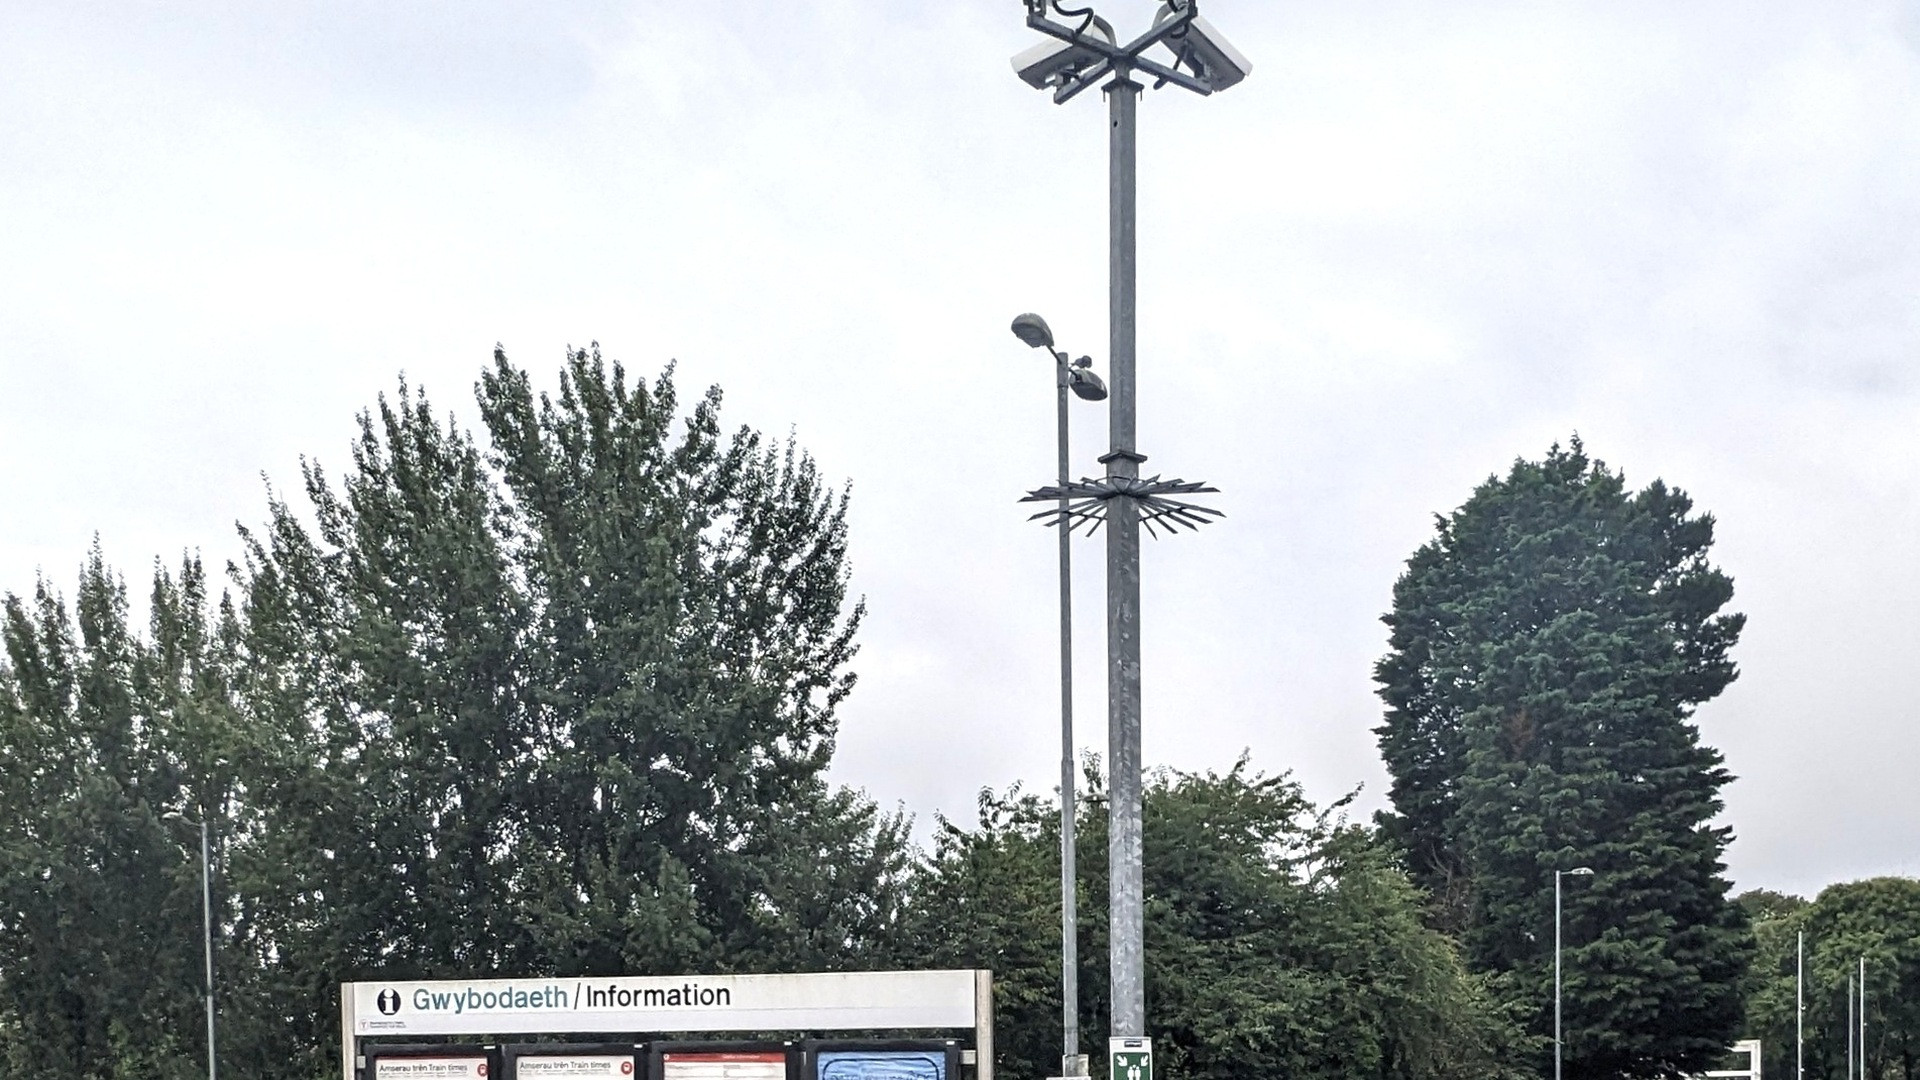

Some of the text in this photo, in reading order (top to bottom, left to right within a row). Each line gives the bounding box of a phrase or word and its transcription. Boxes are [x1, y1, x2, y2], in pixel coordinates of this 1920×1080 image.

[413, 986, 568, 1014] Gwybodaeth
[587, 984, 730, 1007] Information
[379, 1064, 411, 1072] Amserau
[429, 1063, 447, 1071] Train
[448, 1063, 468, 1071] times
[520, 1061, 552, 1069] Amserau
